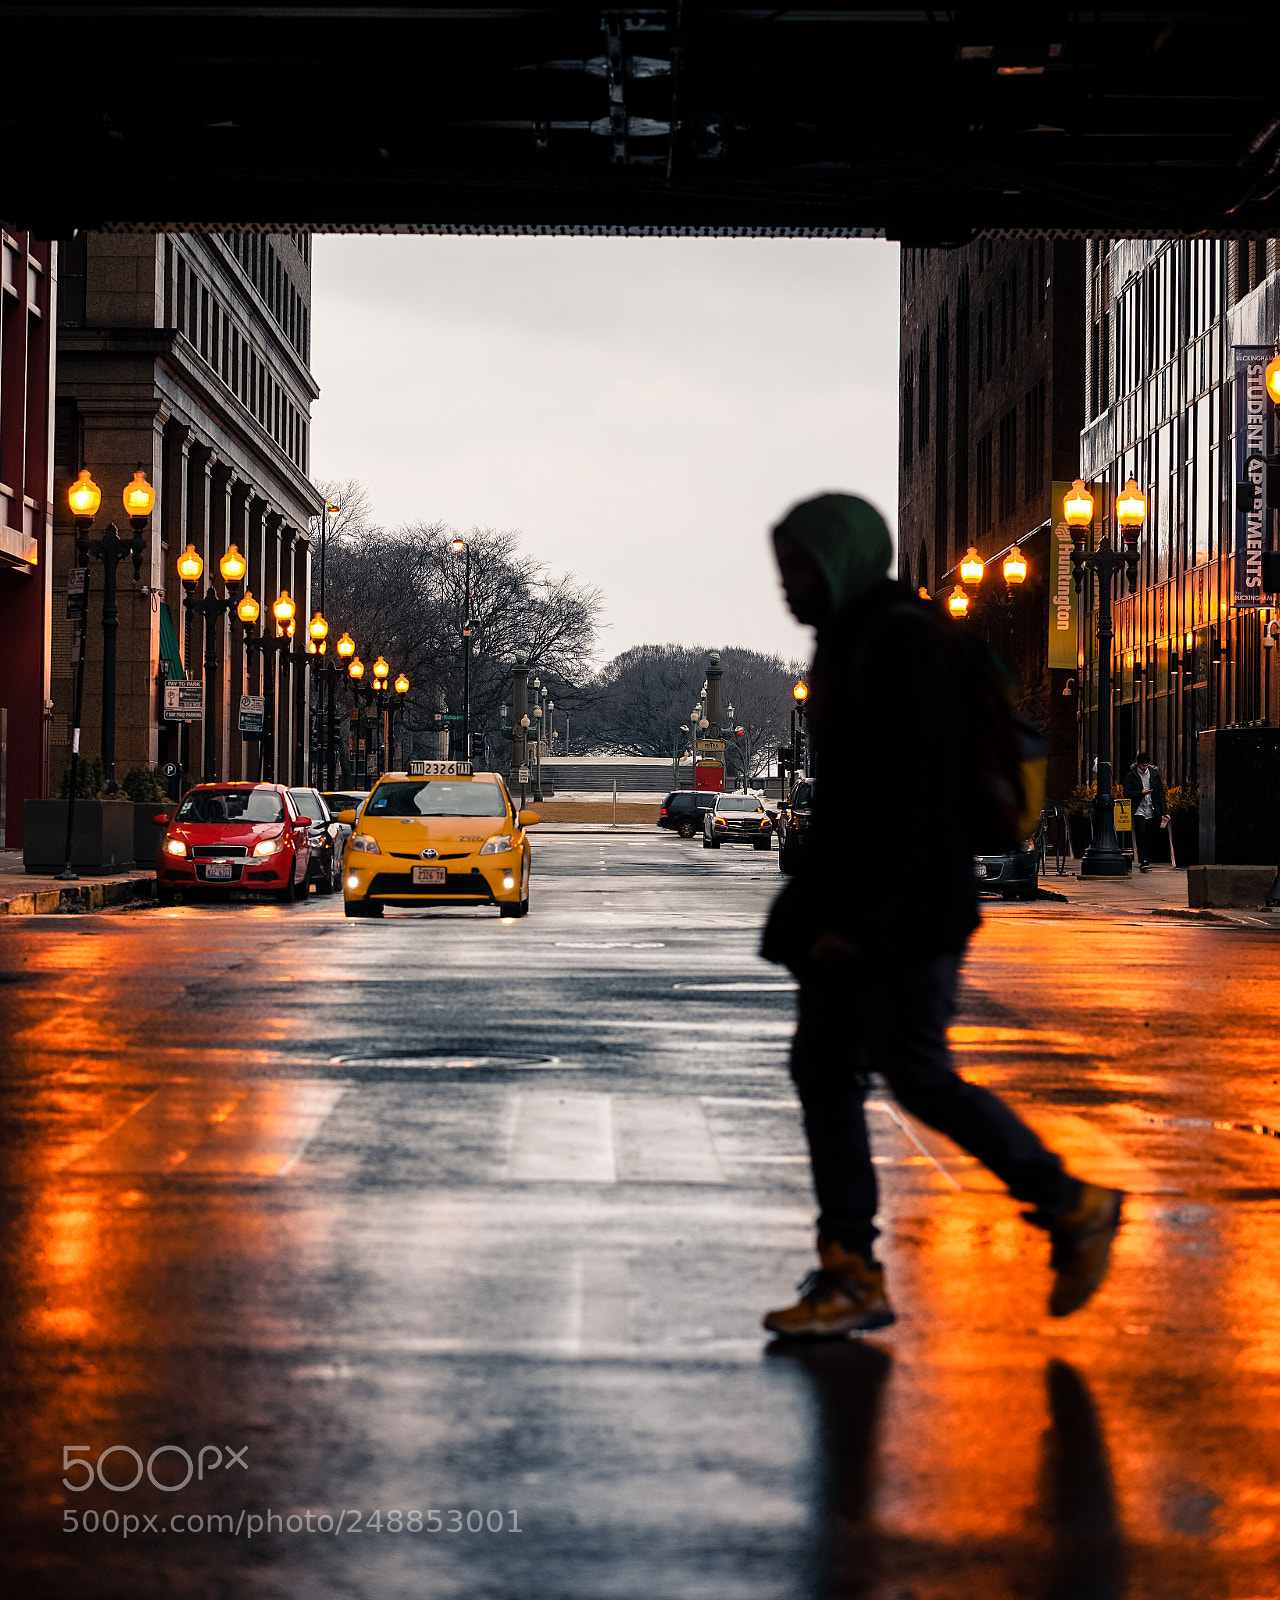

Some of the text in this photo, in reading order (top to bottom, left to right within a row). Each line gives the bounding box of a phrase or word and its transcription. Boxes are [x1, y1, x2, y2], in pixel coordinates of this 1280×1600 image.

[1247, 364, 1263, 452] STUDENT
[1053, 544, 1075, 631] Huntington
[410, 763, 470, 775] TAXI 2326 TAXI
[418, 871, 444, 880] 2326 TX
